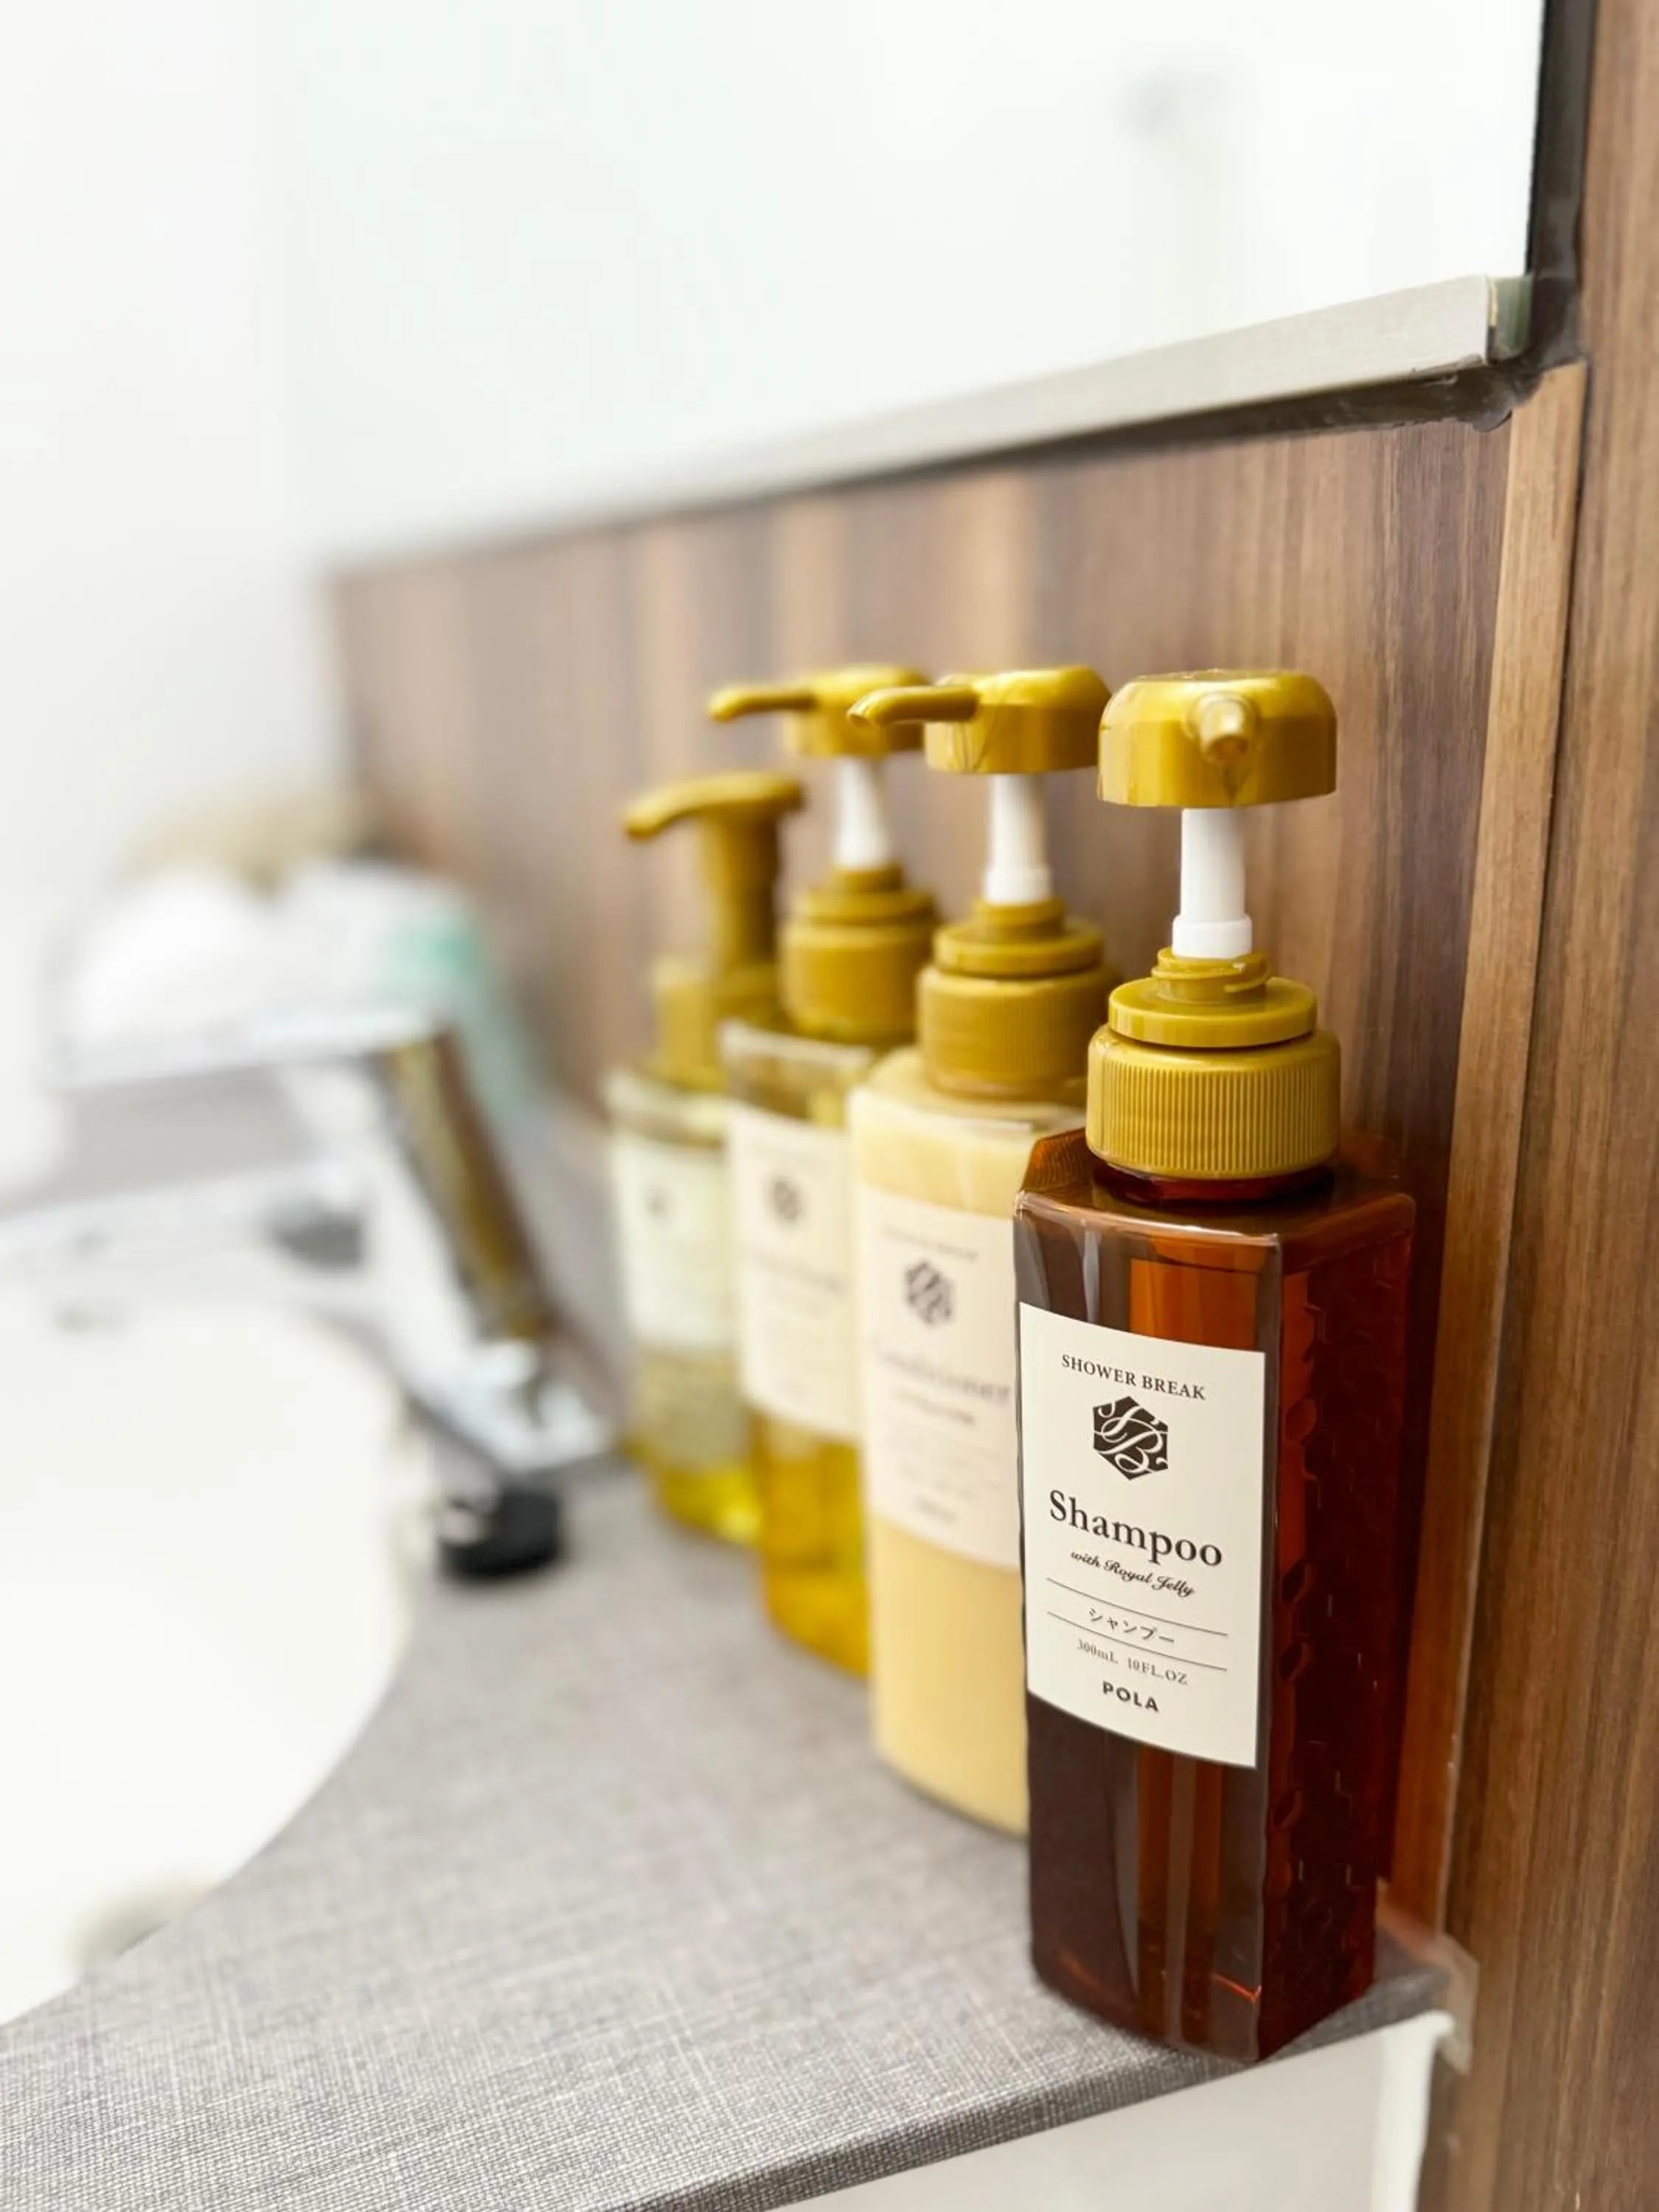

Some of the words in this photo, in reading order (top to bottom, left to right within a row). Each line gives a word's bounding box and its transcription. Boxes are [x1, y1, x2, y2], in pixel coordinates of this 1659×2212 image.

[1062, 1354, 1136, 1386] SHOWER
[1143, 1375, 1206, 1400] BREAK
[1049, 1489, 1222, 1566] Shampoo
[1071, 1551, 1102, 1568] with
[1104, 1559, 1152, 1583] Royal
[1152, 1574, 1194, 1597] Jelly
[1088, 1607, 1175, 1643] シャンプー
[1077, 1638, 1118, 1664] 300mL
[1102, 1681, 1159, 1712] POLA
